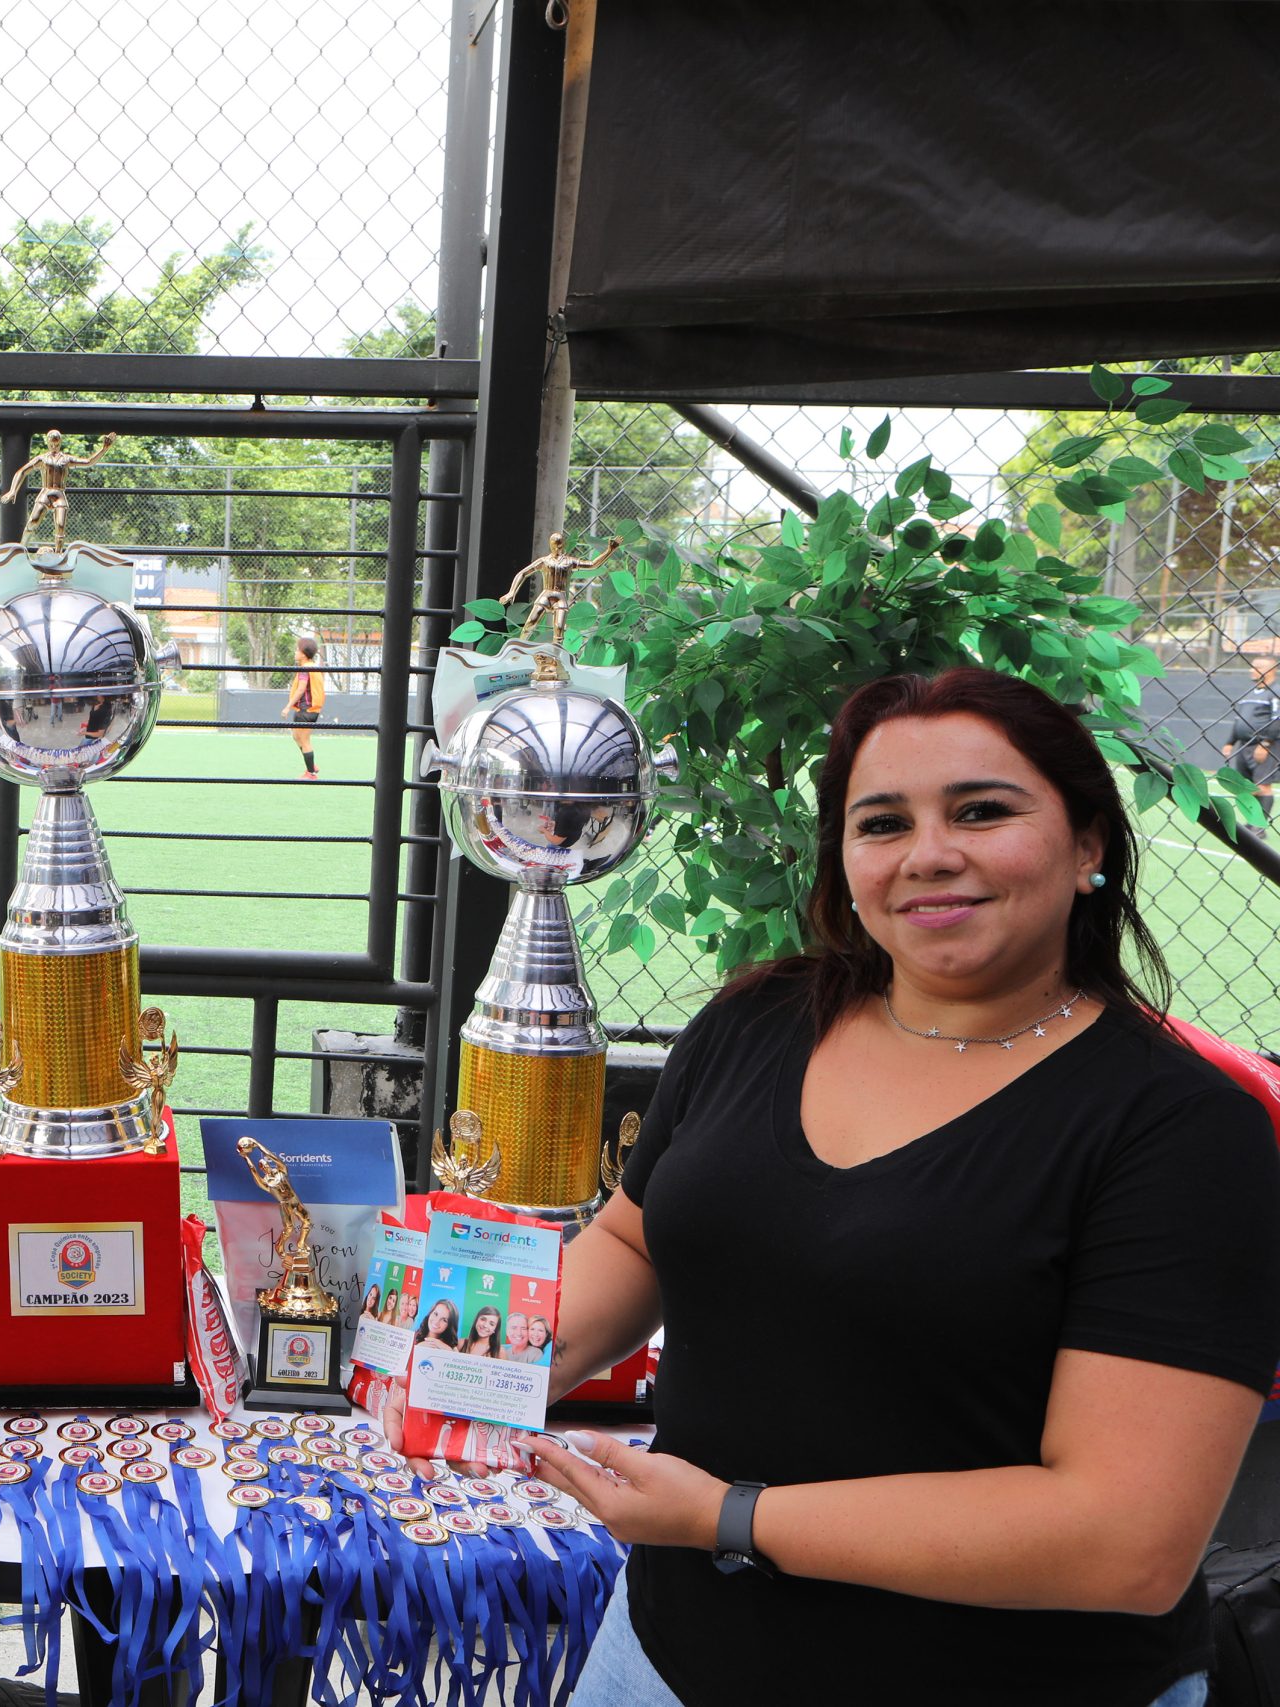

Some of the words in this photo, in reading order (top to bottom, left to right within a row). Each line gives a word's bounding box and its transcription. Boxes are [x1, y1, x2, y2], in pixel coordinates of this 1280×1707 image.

[278, 1152, 333, 1163] Sorridents
[320, 1224, 335, 1235] YOU
[474, 1227, 537, 1247] Sorridents
[50, 1247, 58, 1263] Copa
[54, 1233, 77, 1247] Química
[77, 1233, 93, 1244] entre
[91, 1242, 102, 1269] empresas
[258, 1227, 324, 1268] Kep
[331, 1243, 358, 1257] on
[459, 1247, 484, 1256] Sorridents
[482, 1256, 504, 1264] SORRISO
[60, 1271, 93, 1280] SOCIETY
[26, 1291, 89, 1304] CAMPEÃO
[94, 1293, 129, 1304] 2023
[277, 1369, 300, 1377] GOLEIRO
[443, 1362, 483, 1373] FERRAZÓPOLIS
[492, 1364, 522, 1373] AVALIAÇÃO
[445, 1371, 483, 1385] 4338-7270
[495, 1379, 534, 1393] 2381-3967
[483, 1405, 507, 1413] Demarchi
